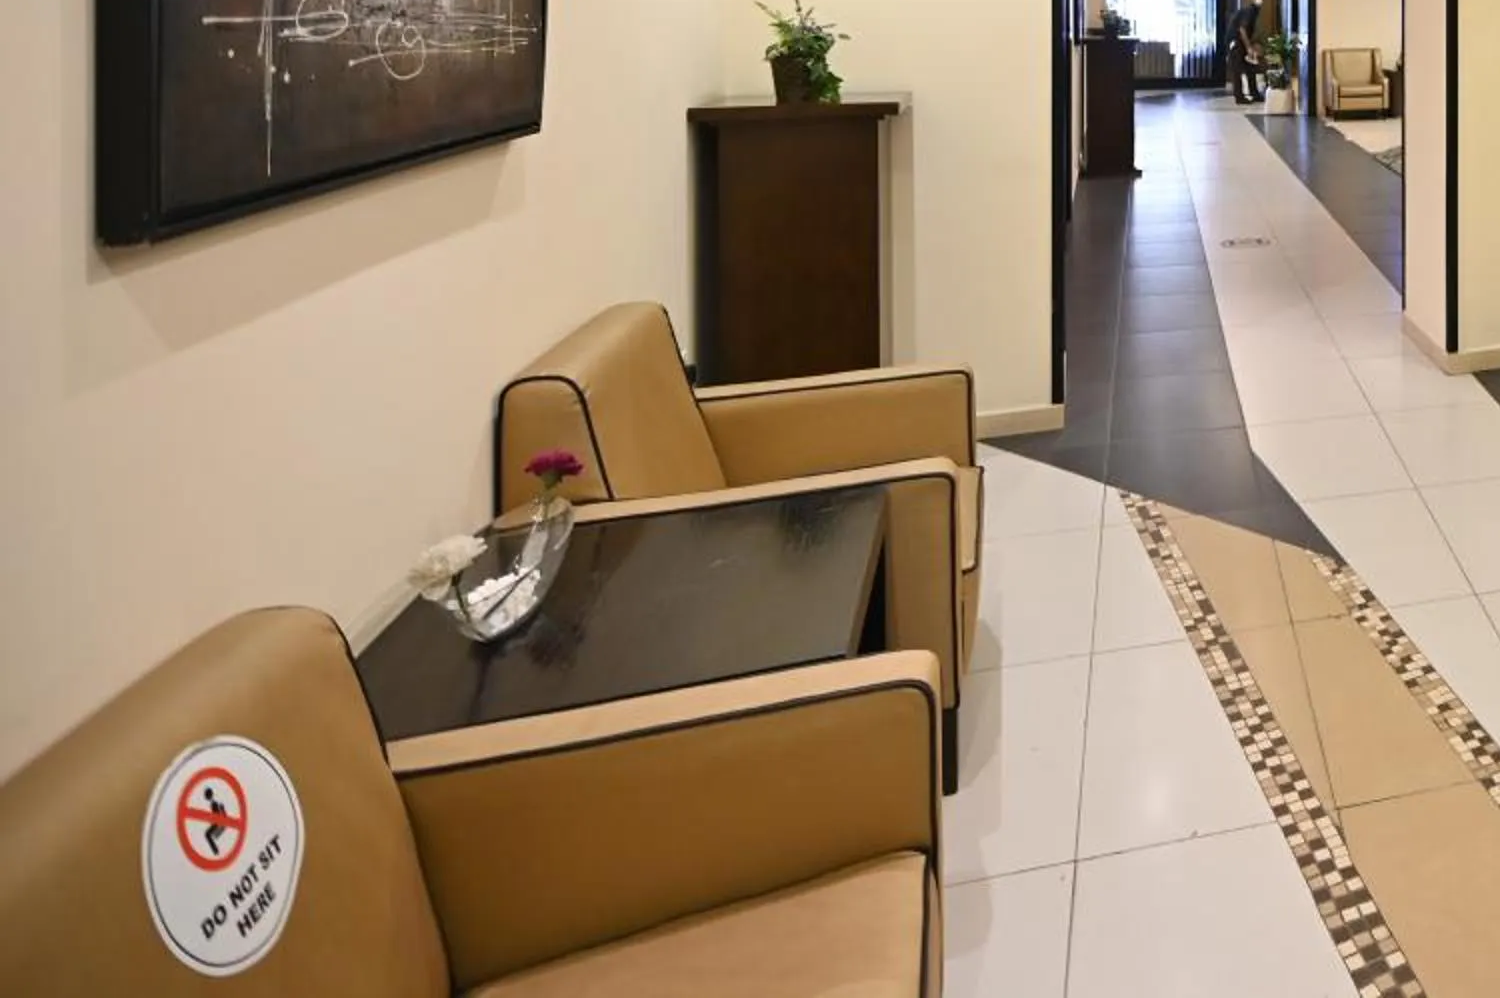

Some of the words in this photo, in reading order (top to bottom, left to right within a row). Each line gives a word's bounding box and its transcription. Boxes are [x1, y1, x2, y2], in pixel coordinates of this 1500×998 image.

[201, 904, 227, 939] DO
[229, 863, 259, 909] NOT
[258, 834, 281, 871] SIT
[236, 881, 276, 937] HERE
